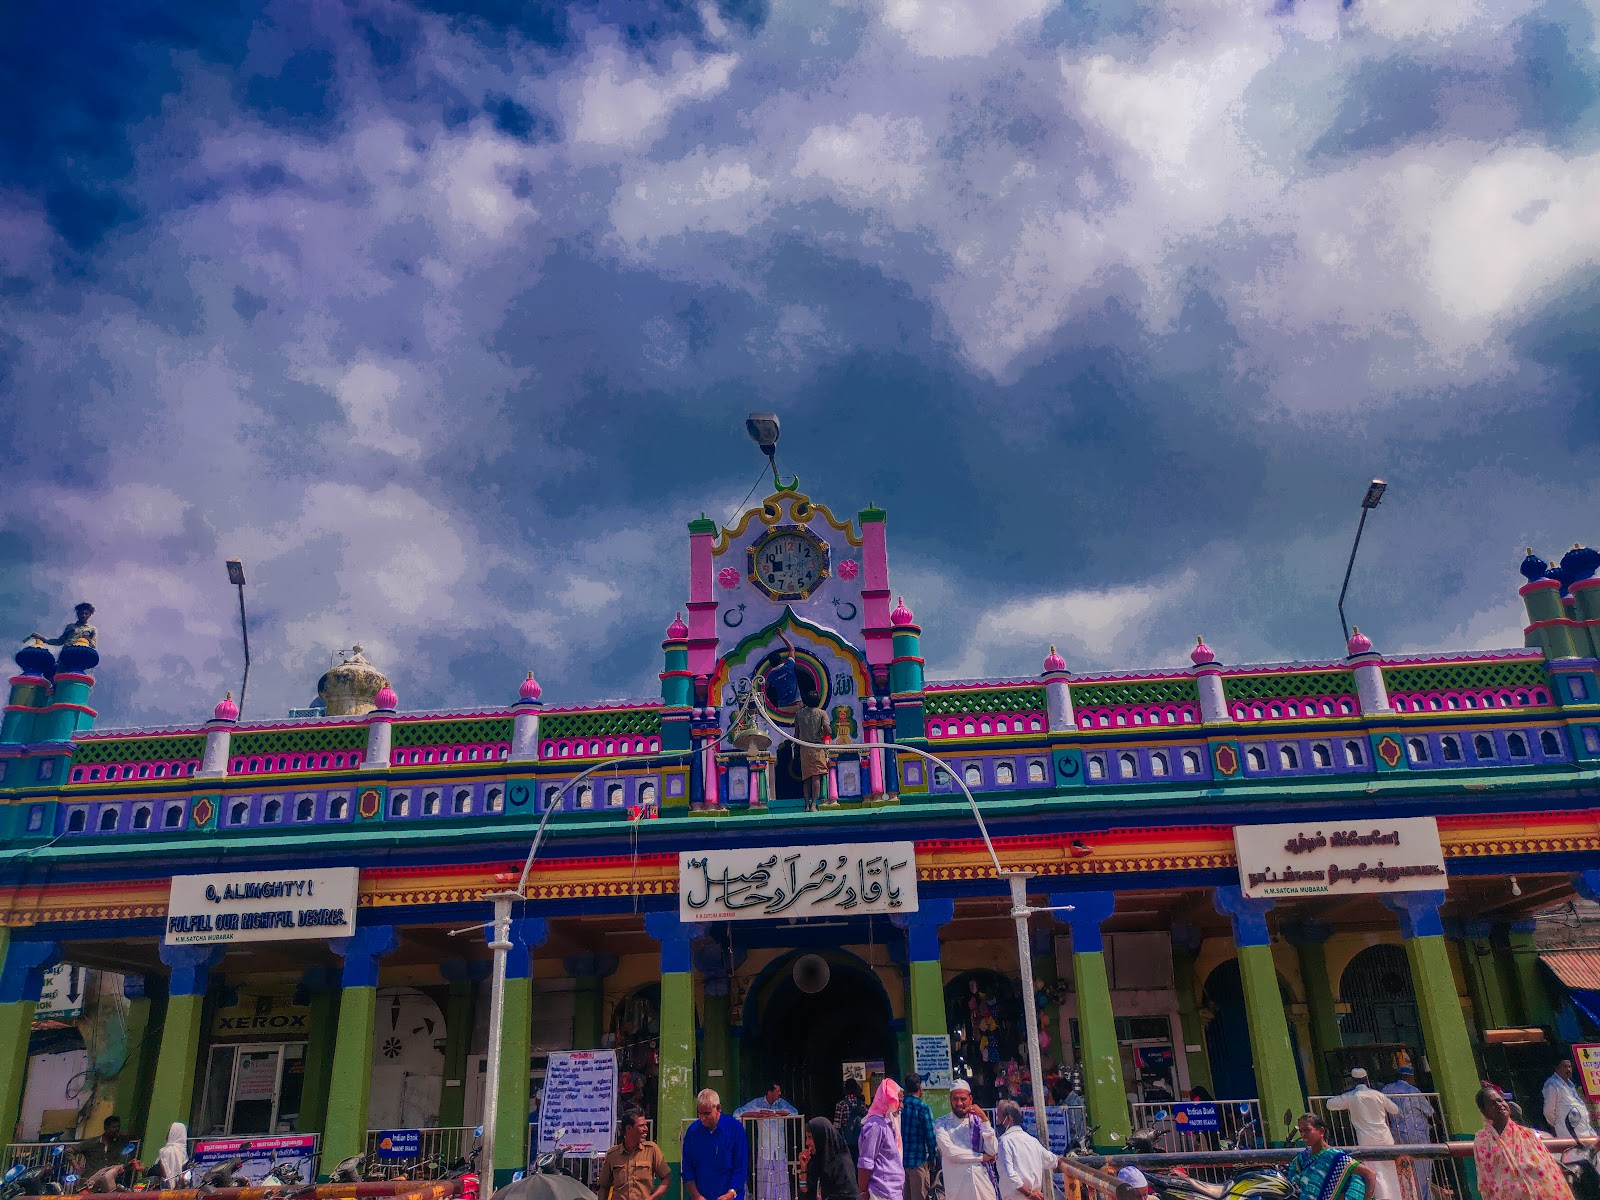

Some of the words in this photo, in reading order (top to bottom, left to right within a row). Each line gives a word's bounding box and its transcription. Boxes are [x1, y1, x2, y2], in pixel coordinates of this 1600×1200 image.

[775, 544, 782, 554] 11
[784, 541, 794, 552] 12
[804, 548, 811, 557] 2
[766, 553, 776, 563] 10
[768, 574, 775, 583] 8
[806, 571, 812, 580] 4
[778, 580, 784, 589] 7
[798, 578, 805, 588] 5
[1300, 885, 1329, 893] MUBARAK
[169, 914, 213, 933] FULFILL
[215, 914, 239, 931] OUR
[241, 910, 295, 930] RIGHTFUL
[298, 908, 348, 927] DESIRES.
[208, 933, 234, 941] MUBARAK
[217, 1014, 308, 1030] XEROX
[1203, 1107, 1215, 1115] Bank
